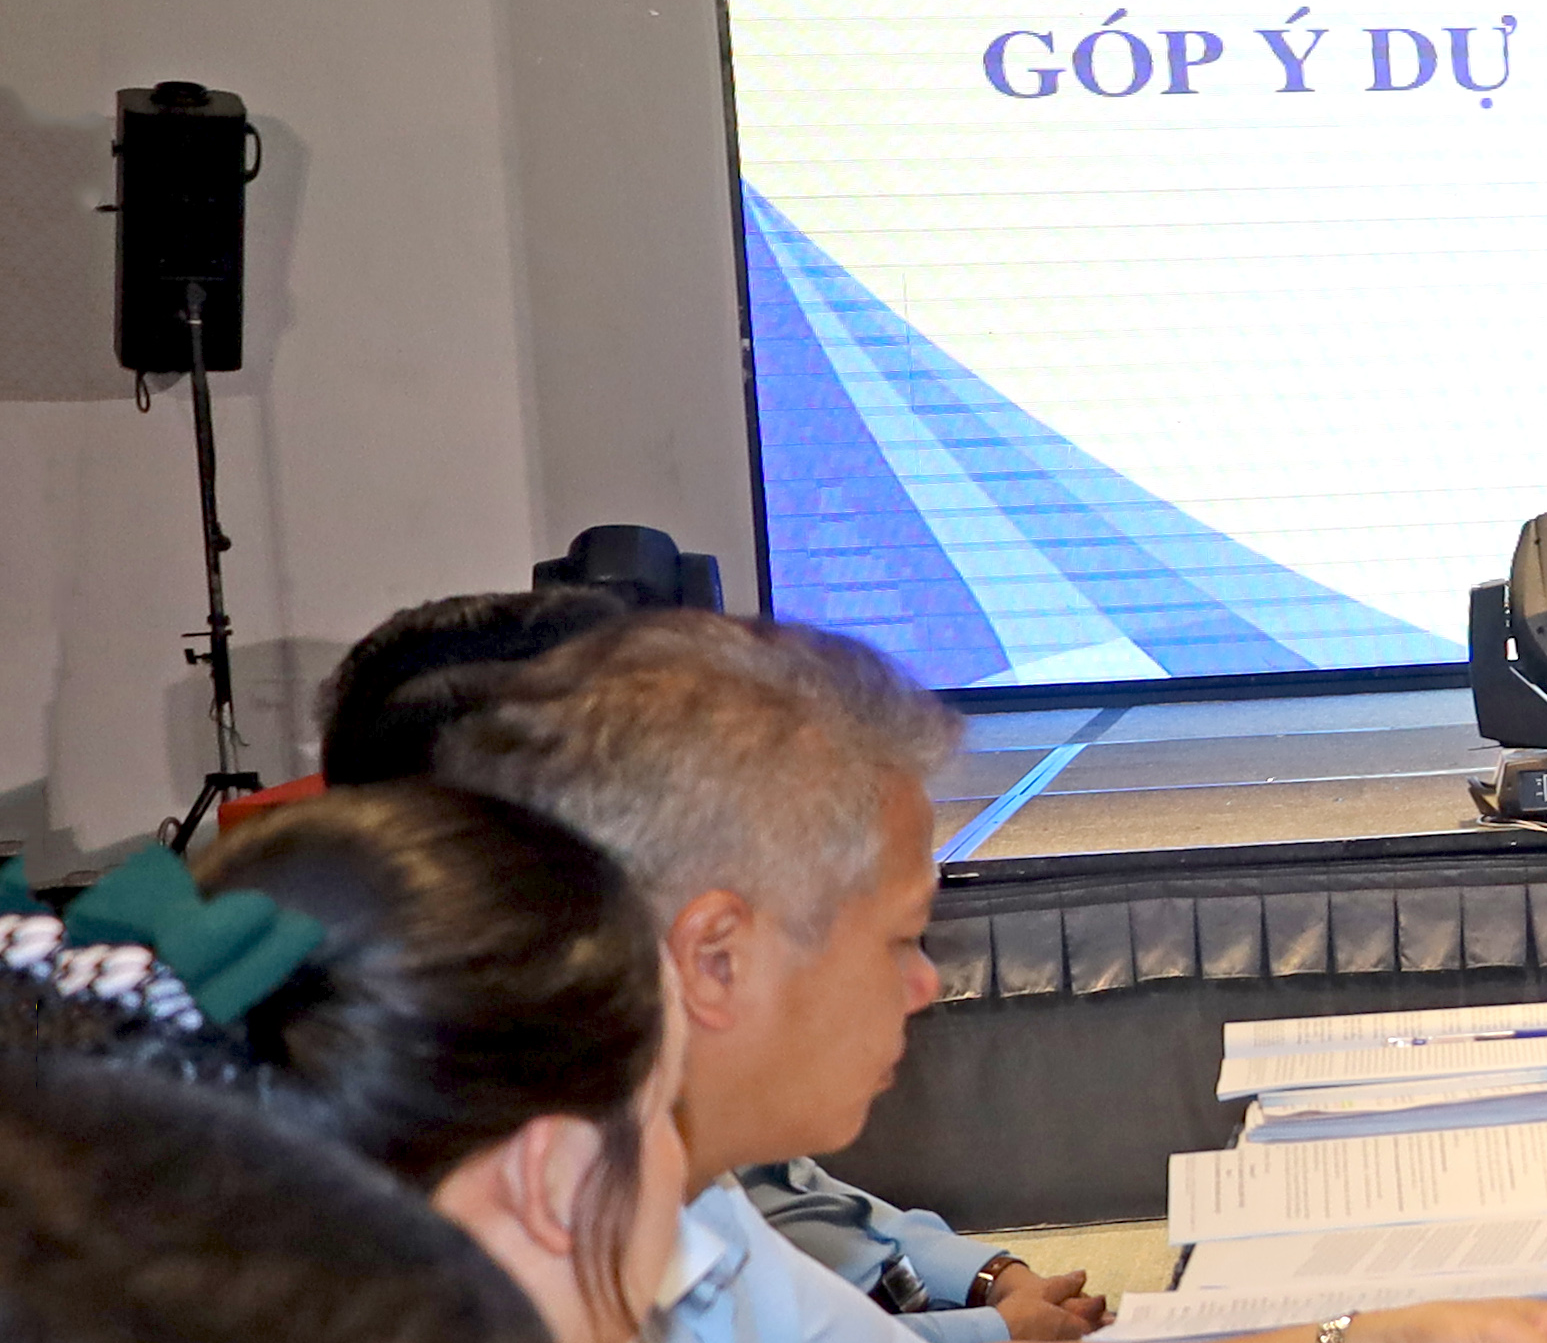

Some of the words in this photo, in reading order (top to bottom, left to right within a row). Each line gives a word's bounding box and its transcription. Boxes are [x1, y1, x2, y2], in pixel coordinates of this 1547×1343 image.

[982, 7, 1224, 99] GÓP
[1252, 5, 1330, 93] Ý
[1361, 14, 1518, 110] DỰ
